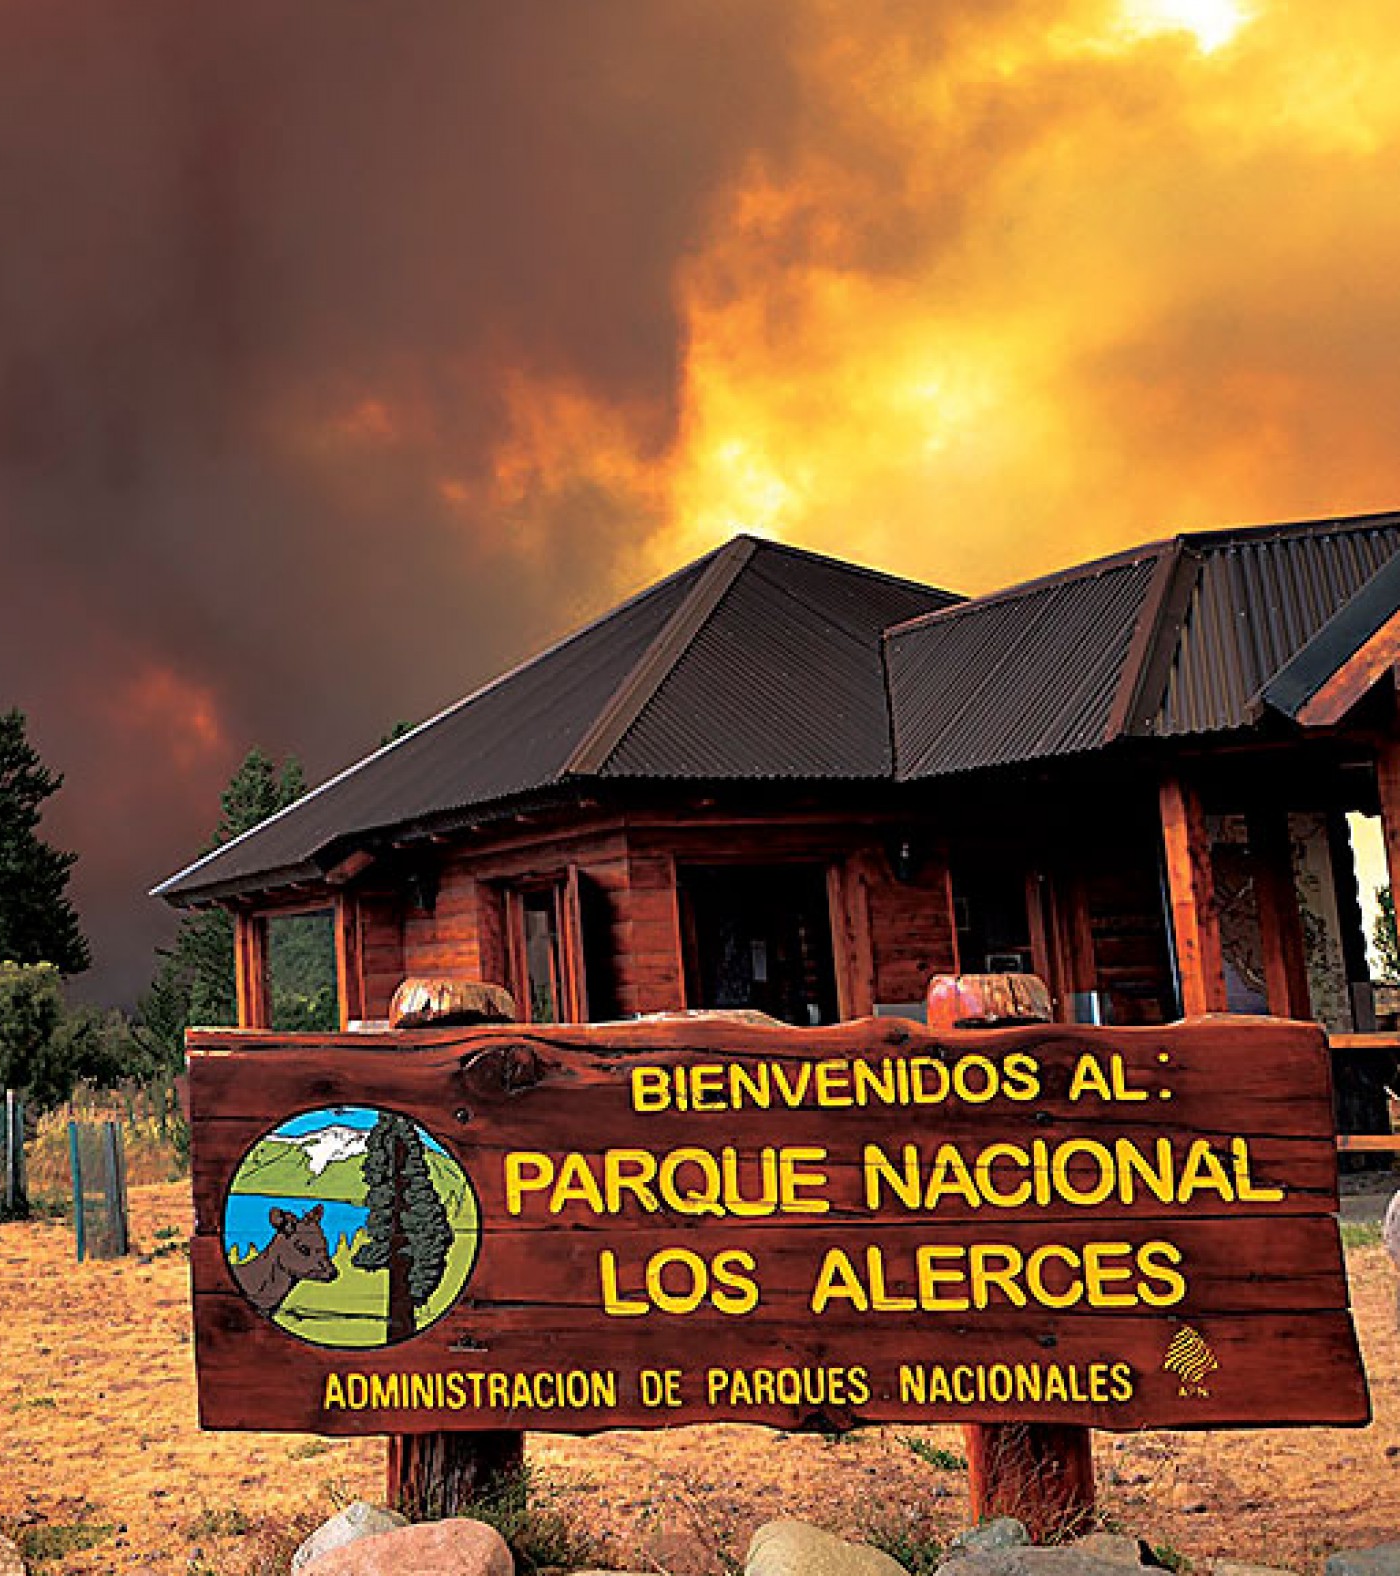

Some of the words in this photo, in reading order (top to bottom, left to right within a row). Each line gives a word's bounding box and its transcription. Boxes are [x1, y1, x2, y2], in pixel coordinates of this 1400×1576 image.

[632, 1053, 1039, 1111] BIENVENIDOS
[1069, 1053, 1172, 1100] AL:
[506, 1148, 829, 1216] PARQUE
[864, 1138, 1284, 1210] NACIONAL
[601, 1249, 758, 1315] LOS
[812, 1242, 1186, 1313] ALERCES
[325, 1371, 616, 1409] ADMINISTRACION
[641, 1370, 682, 1406] DE
[708, 1366, 870, 1404] PARQUES
[900, 1363, 1133, 1403] NACIONALES
